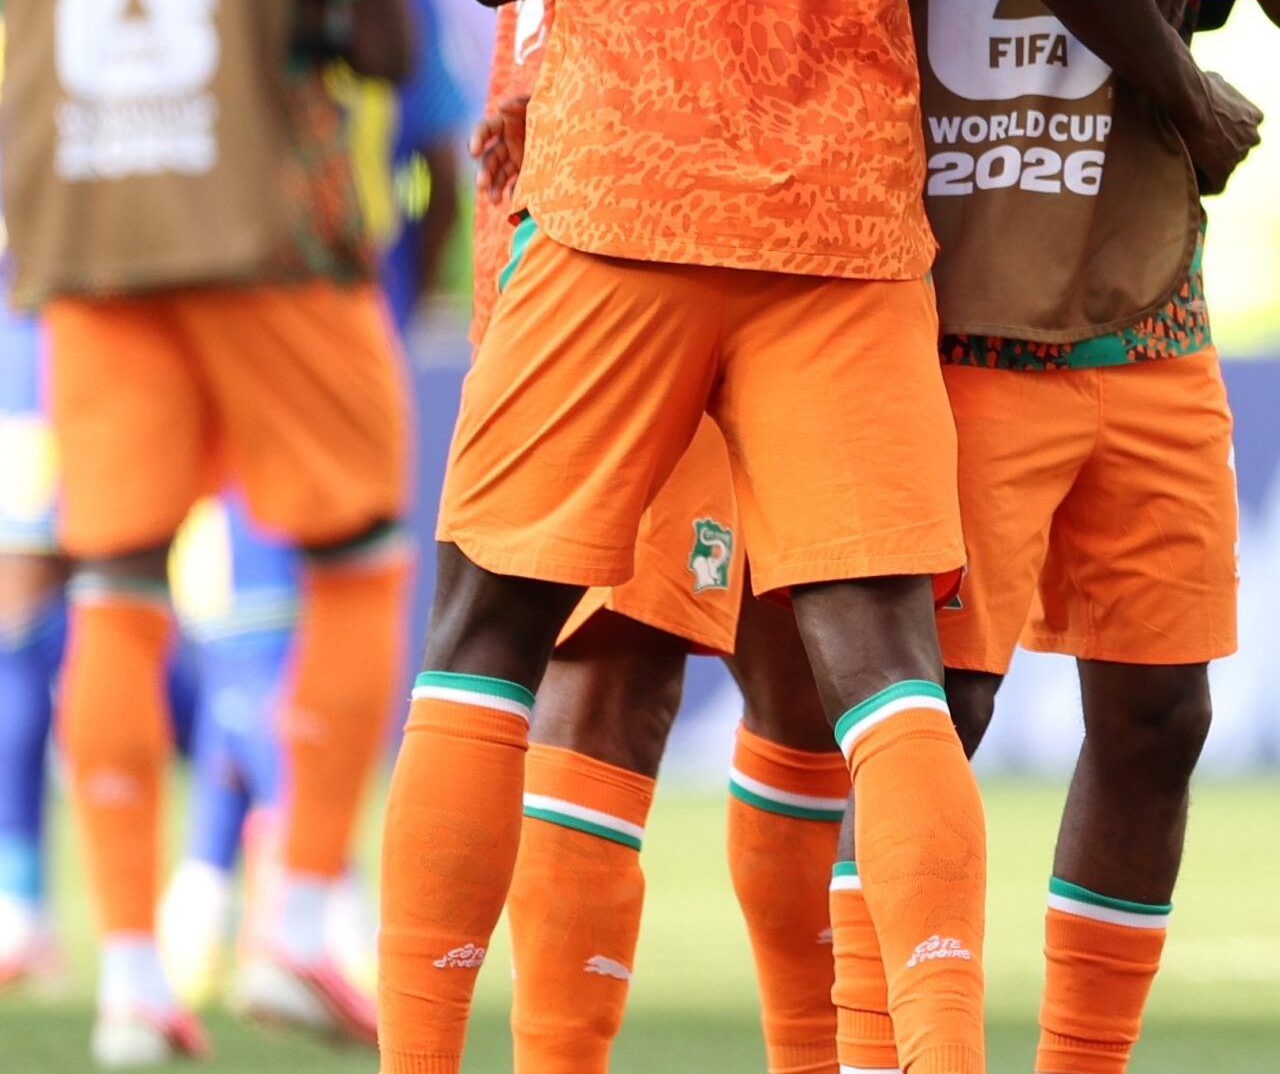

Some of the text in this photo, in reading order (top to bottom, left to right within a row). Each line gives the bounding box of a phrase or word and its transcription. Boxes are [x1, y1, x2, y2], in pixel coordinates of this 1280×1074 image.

[988, 33, 1068, 68] FIFA
[928, 109, 1113, 144] WORLD CUP
[927, 145, 1106, 196] 2026
